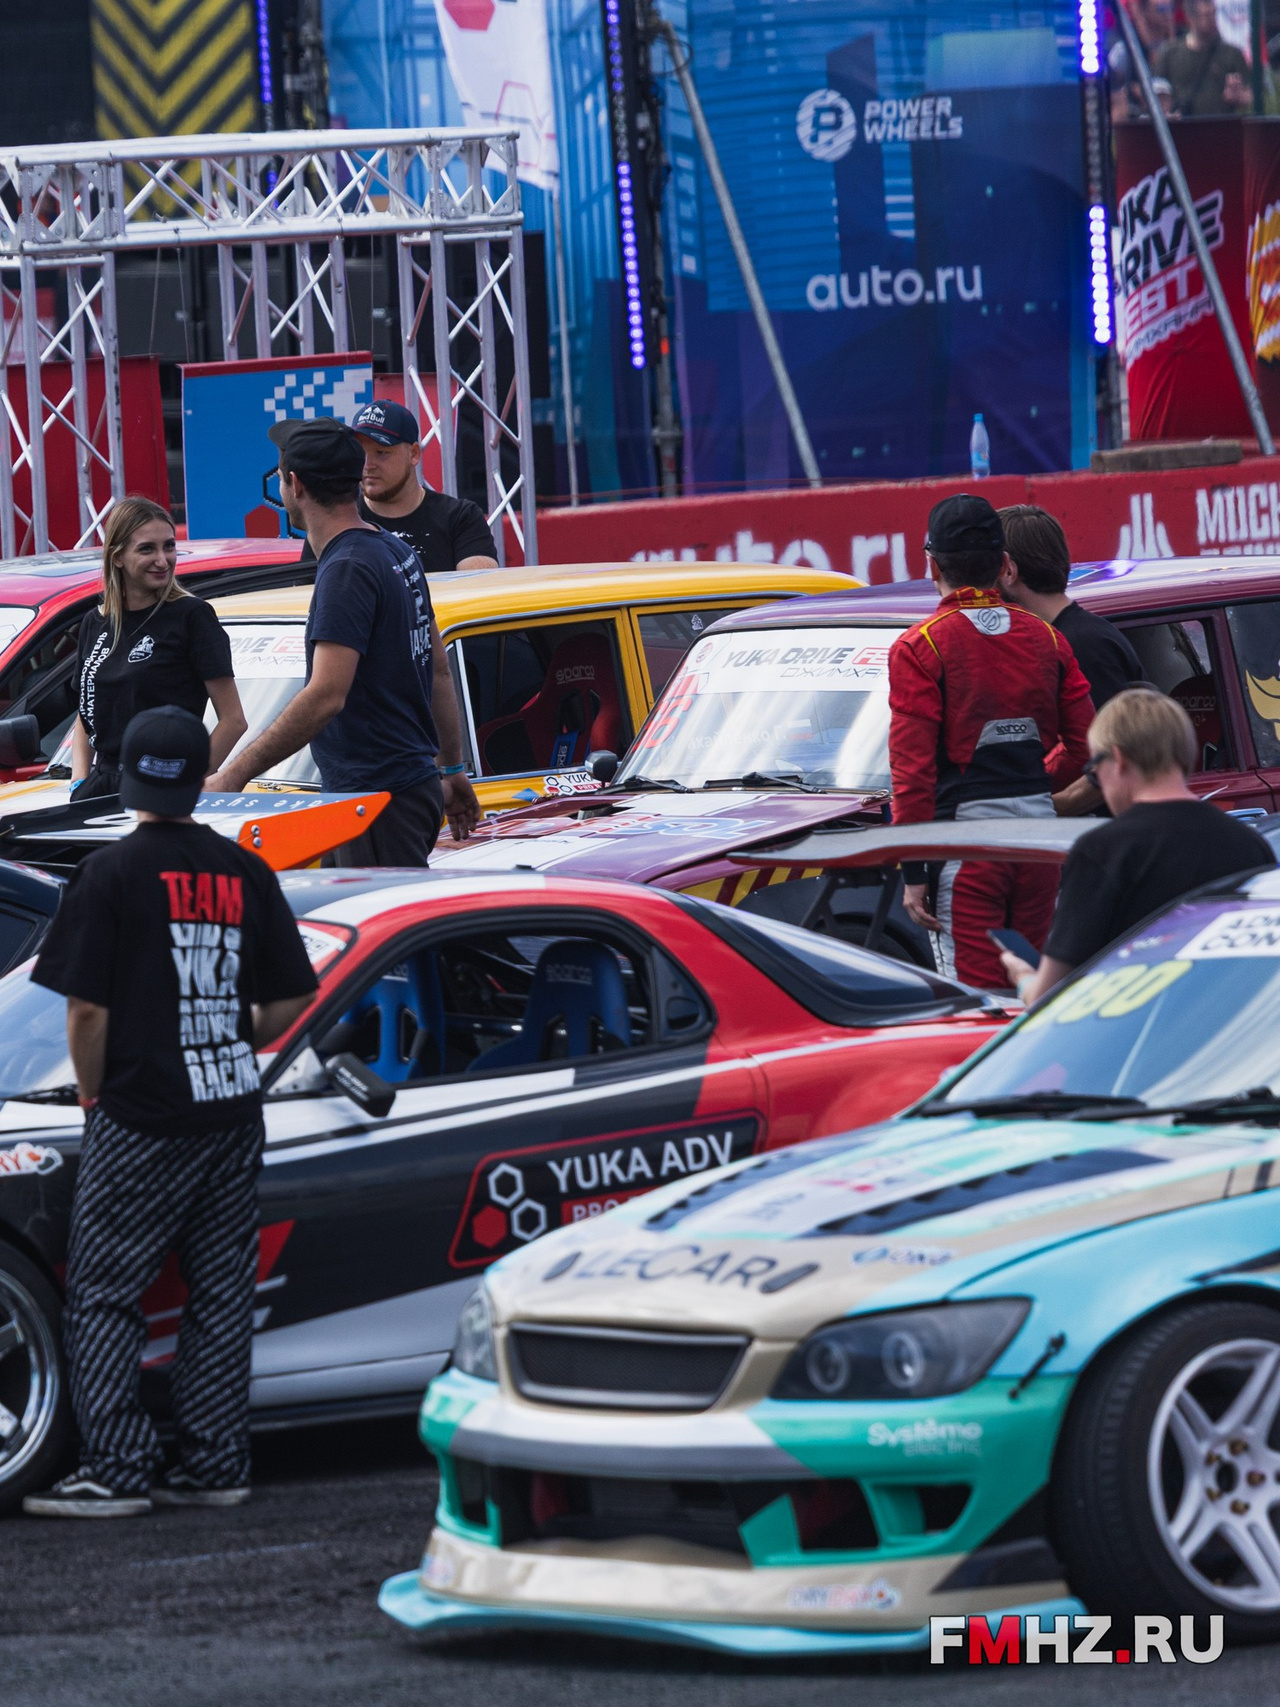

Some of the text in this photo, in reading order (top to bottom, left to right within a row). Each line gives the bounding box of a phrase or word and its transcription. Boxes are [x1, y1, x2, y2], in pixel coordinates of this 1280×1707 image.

[863, 97, 952, 120] POWER
[863, 117, 963, 143] WHEELS
[806, 265, 984, 312] auto.ru
[370, 413, 386, 424] Bull
[721, 649, 776, 668] YUKA
[778, 647, 856, 665] DRIVE
[87, 647, 111, 718] МАТЕРИАЛОВ
[555, 665, 595, 684] sparco
[780, 667, 890, 679] ДЖИМХА
[996, 723, 1028, 735] sparco
[563, 773, 594, 784] YUK
[160, 871, 244, 925] TEAM
[547, 1130, 733, 1193] YUKA ADV
